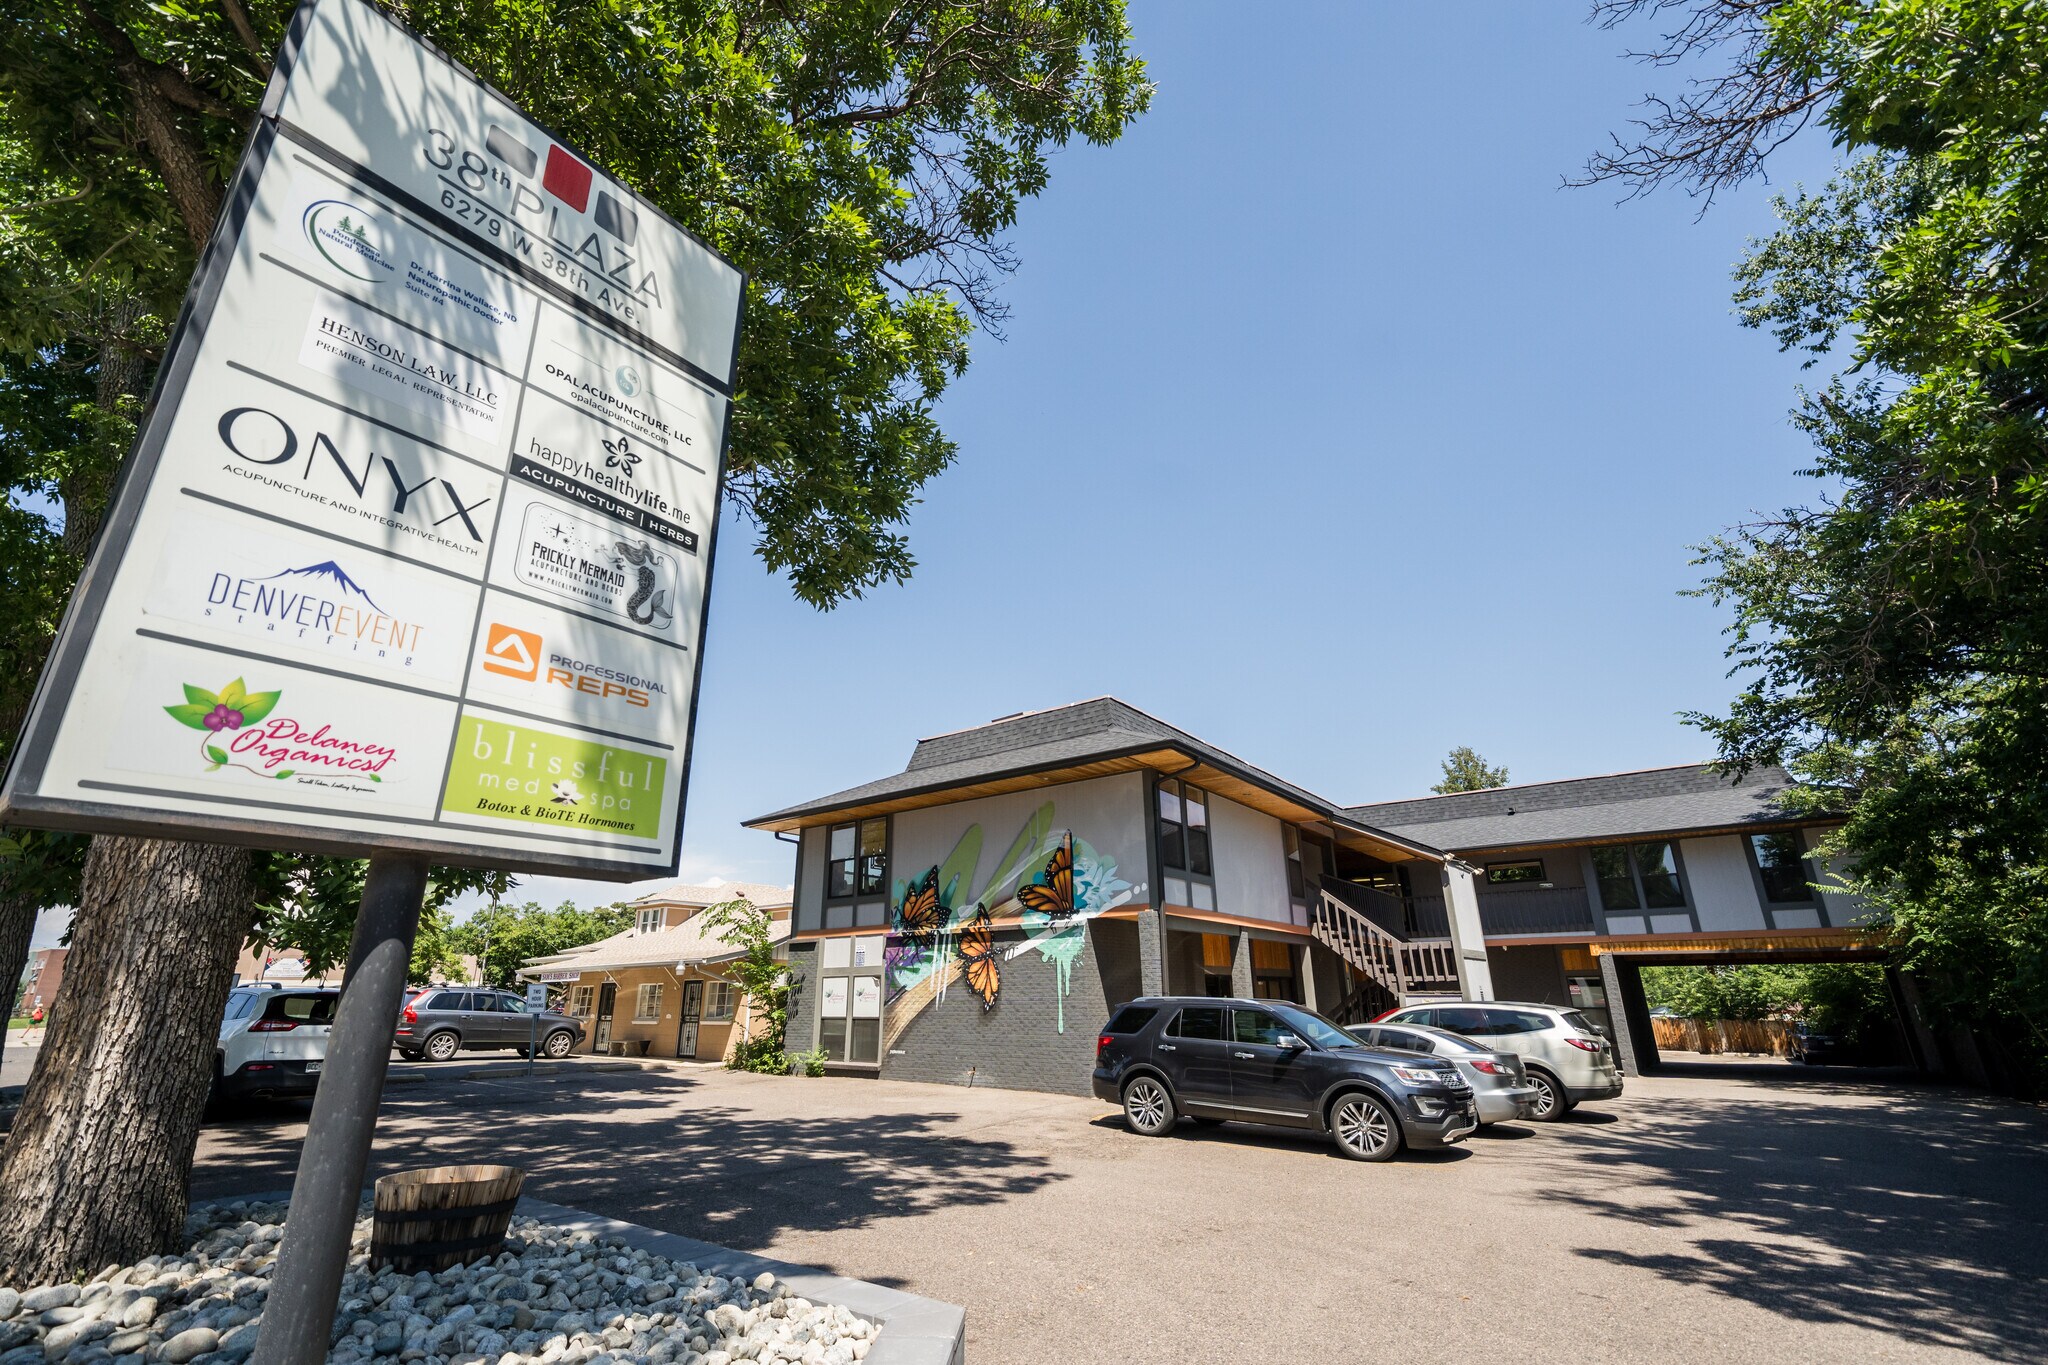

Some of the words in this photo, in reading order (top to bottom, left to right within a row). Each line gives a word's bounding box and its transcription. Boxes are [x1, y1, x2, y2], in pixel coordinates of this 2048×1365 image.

[332, 228, 381, 258] Ponderosa
[422, 128, 512, 192] 38th
[510, 182, 662, 310] PLAZA
[318, 227, 353, 250] Natural
[355, 246, 395, 272] Medicine
[440, 189, 502, 238] 6279
[512, 231, 534, 256] W
[541, 251, 590, 293] 38th
[597, 287, 641, 324] Ave.
[404, 281, 430, 299] Suite
[432, 295, 445, 307] #4
[407, 271, 471, 310] Naturopathic
[472, 305, 504, 326] Doctor
[410, 261, 424, 274] Dr.
[426, 269, 461, 293] Karrina
[464, 287, 502, 315] Wallace,
[503, 310, 518, 323] ND
[316, 339, 366, 367] PREMIER
[371, 364, 408, 385] LEGAL
[413, 381, 495, 423] REPRESENTATION
[320, 317, 406, 364] HENSON
[410, 357, 458, 390] LAW,
[465, 382, 498, 406] LLC
[545, 364, 580, 388] OPAL
[581, 383, 672, 436] ACUPUNCTURE,
[674, 430, 692, 446] LLC
[570, 391, 669, 446] opalacupuncture.com
[217, 407, 491, 543] ONYX
[530, 437, 691, 524] happyhealthylife.me
[222, 464, 327, 504] ACUPUNCTURE
[329, 500, 357, 514] AND
[359, 510, 435, 542] INTEGRATIVE
[437, 537, 478, 557] HEALTH
[520, 465, 635, 520] ACUPUNCTURE
[649, 520, 693, 546] HERBS
[530, 558, 582, 582] ACUPUNCTURE
[585, 577, 599, 588] AND
[602, 582, 623, 596] HERBS
[531, 542, 576, 570] PRICKLY
[579, 560, 625, 588] MERMAID
[204, 606, 413, 665] staffing
[546, 667, 649, 708] REPS
[549, 653, 667, 695] PROFESSIONAL
[230, 729, 378, 771] Organics
[266, 718, 397, 772] Delaney
[473, 724, 653, 791] blissful
[476, 798, 517, 814] Botox
[520, 804, 531, 816] &
[535, 806, 575, 823] BioTE
[578, 813, 636, 832] Hormones
[478, 772, 540, 796] med
[589, 791, 631, 811] spa
